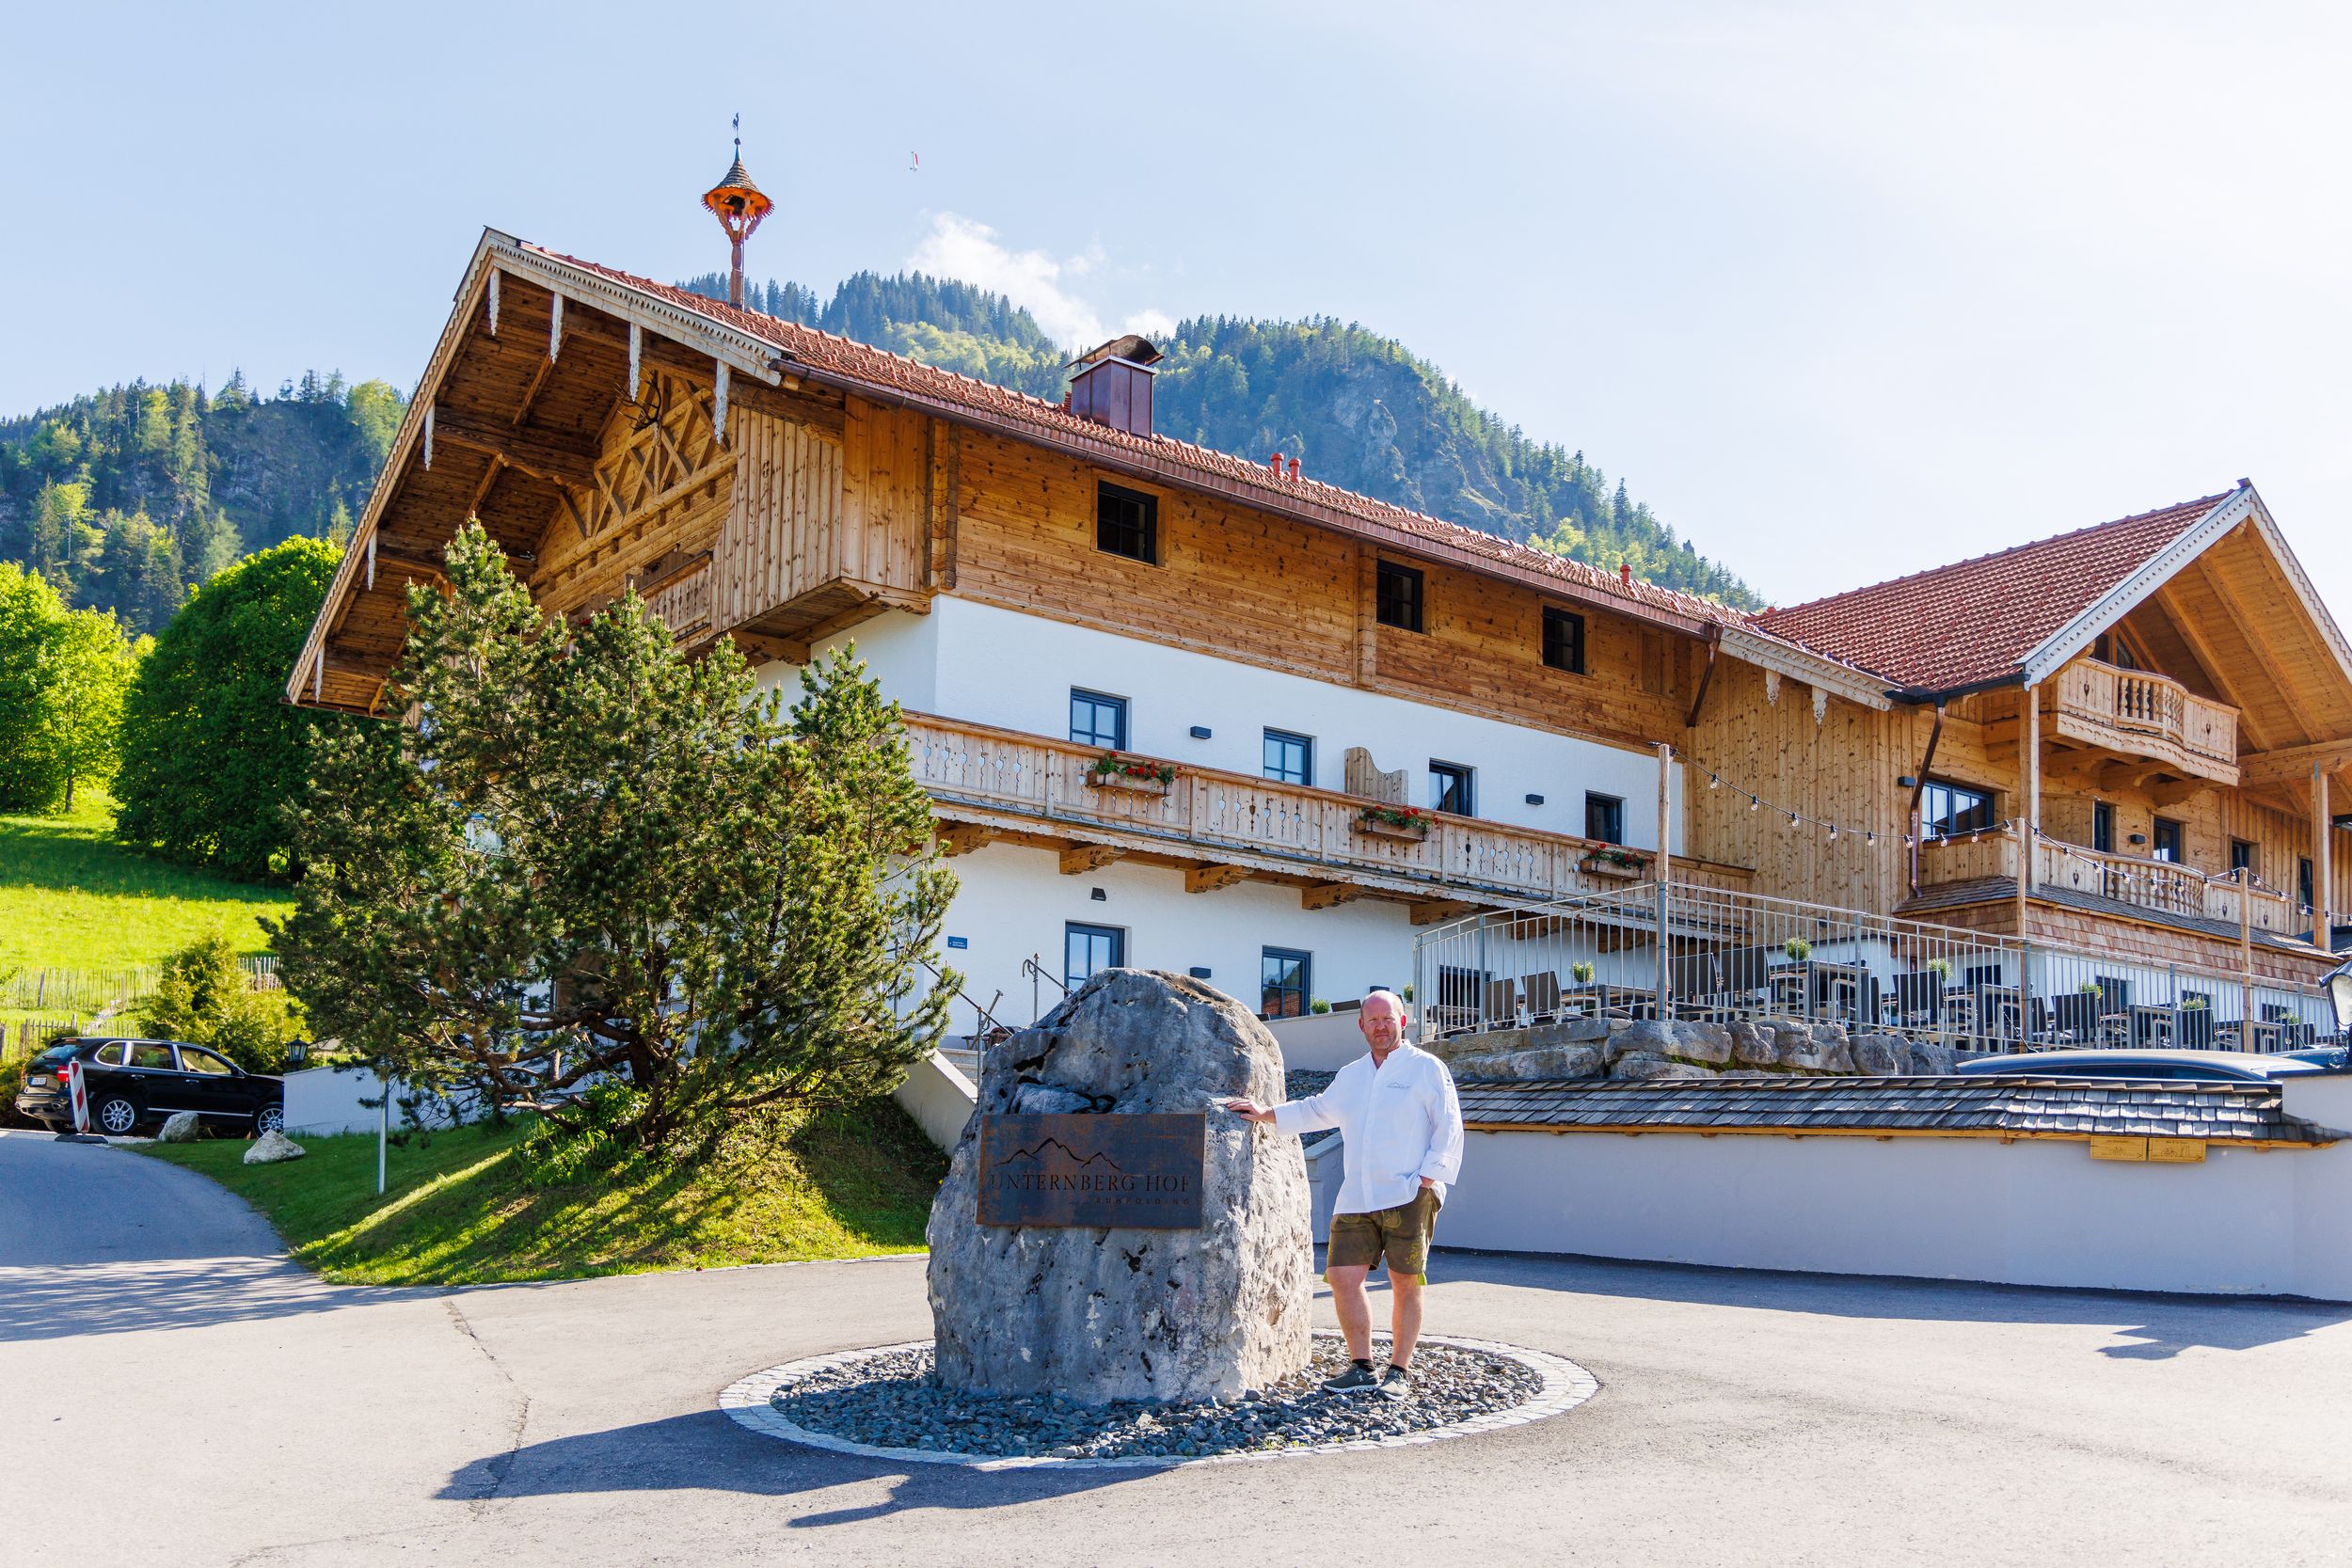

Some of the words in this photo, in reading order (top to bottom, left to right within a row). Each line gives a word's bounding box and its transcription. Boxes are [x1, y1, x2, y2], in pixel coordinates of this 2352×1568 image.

[991, 1175, 1135, 1191] UNTERNBERG
[1146, 1175, 1192, 1192] HOF
[1096, 1196, 1190, 1205] RUHPOLDING
